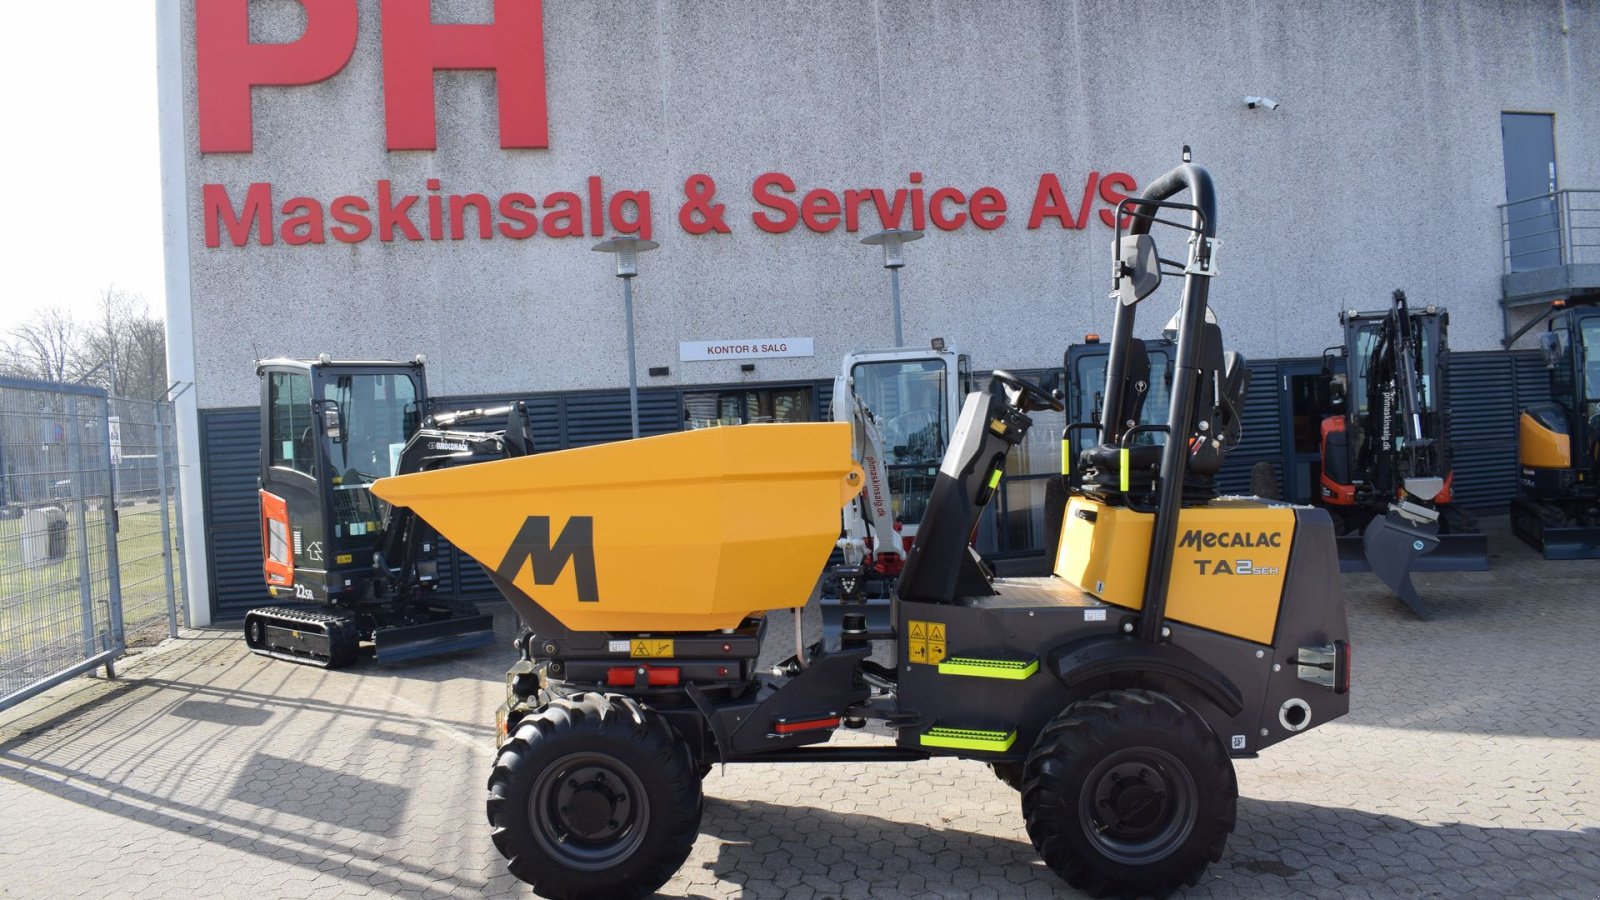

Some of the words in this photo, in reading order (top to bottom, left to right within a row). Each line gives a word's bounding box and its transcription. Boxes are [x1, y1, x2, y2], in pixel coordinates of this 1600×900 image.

[195, 0, 548, 153] PH
[203, 176, 652, 248] Maskinsalg
[678, 173, 731, 234] &
[752, 172, 1007, 233] Service
[1027, 171, 1138, 230] A/S
[706, 344, 750, 355] KONTOR
[752, 344, 760, 353] &
[760, 343, 788, 353] SALG
[865, 456, 886, 518] phmaskinsalg.dk
